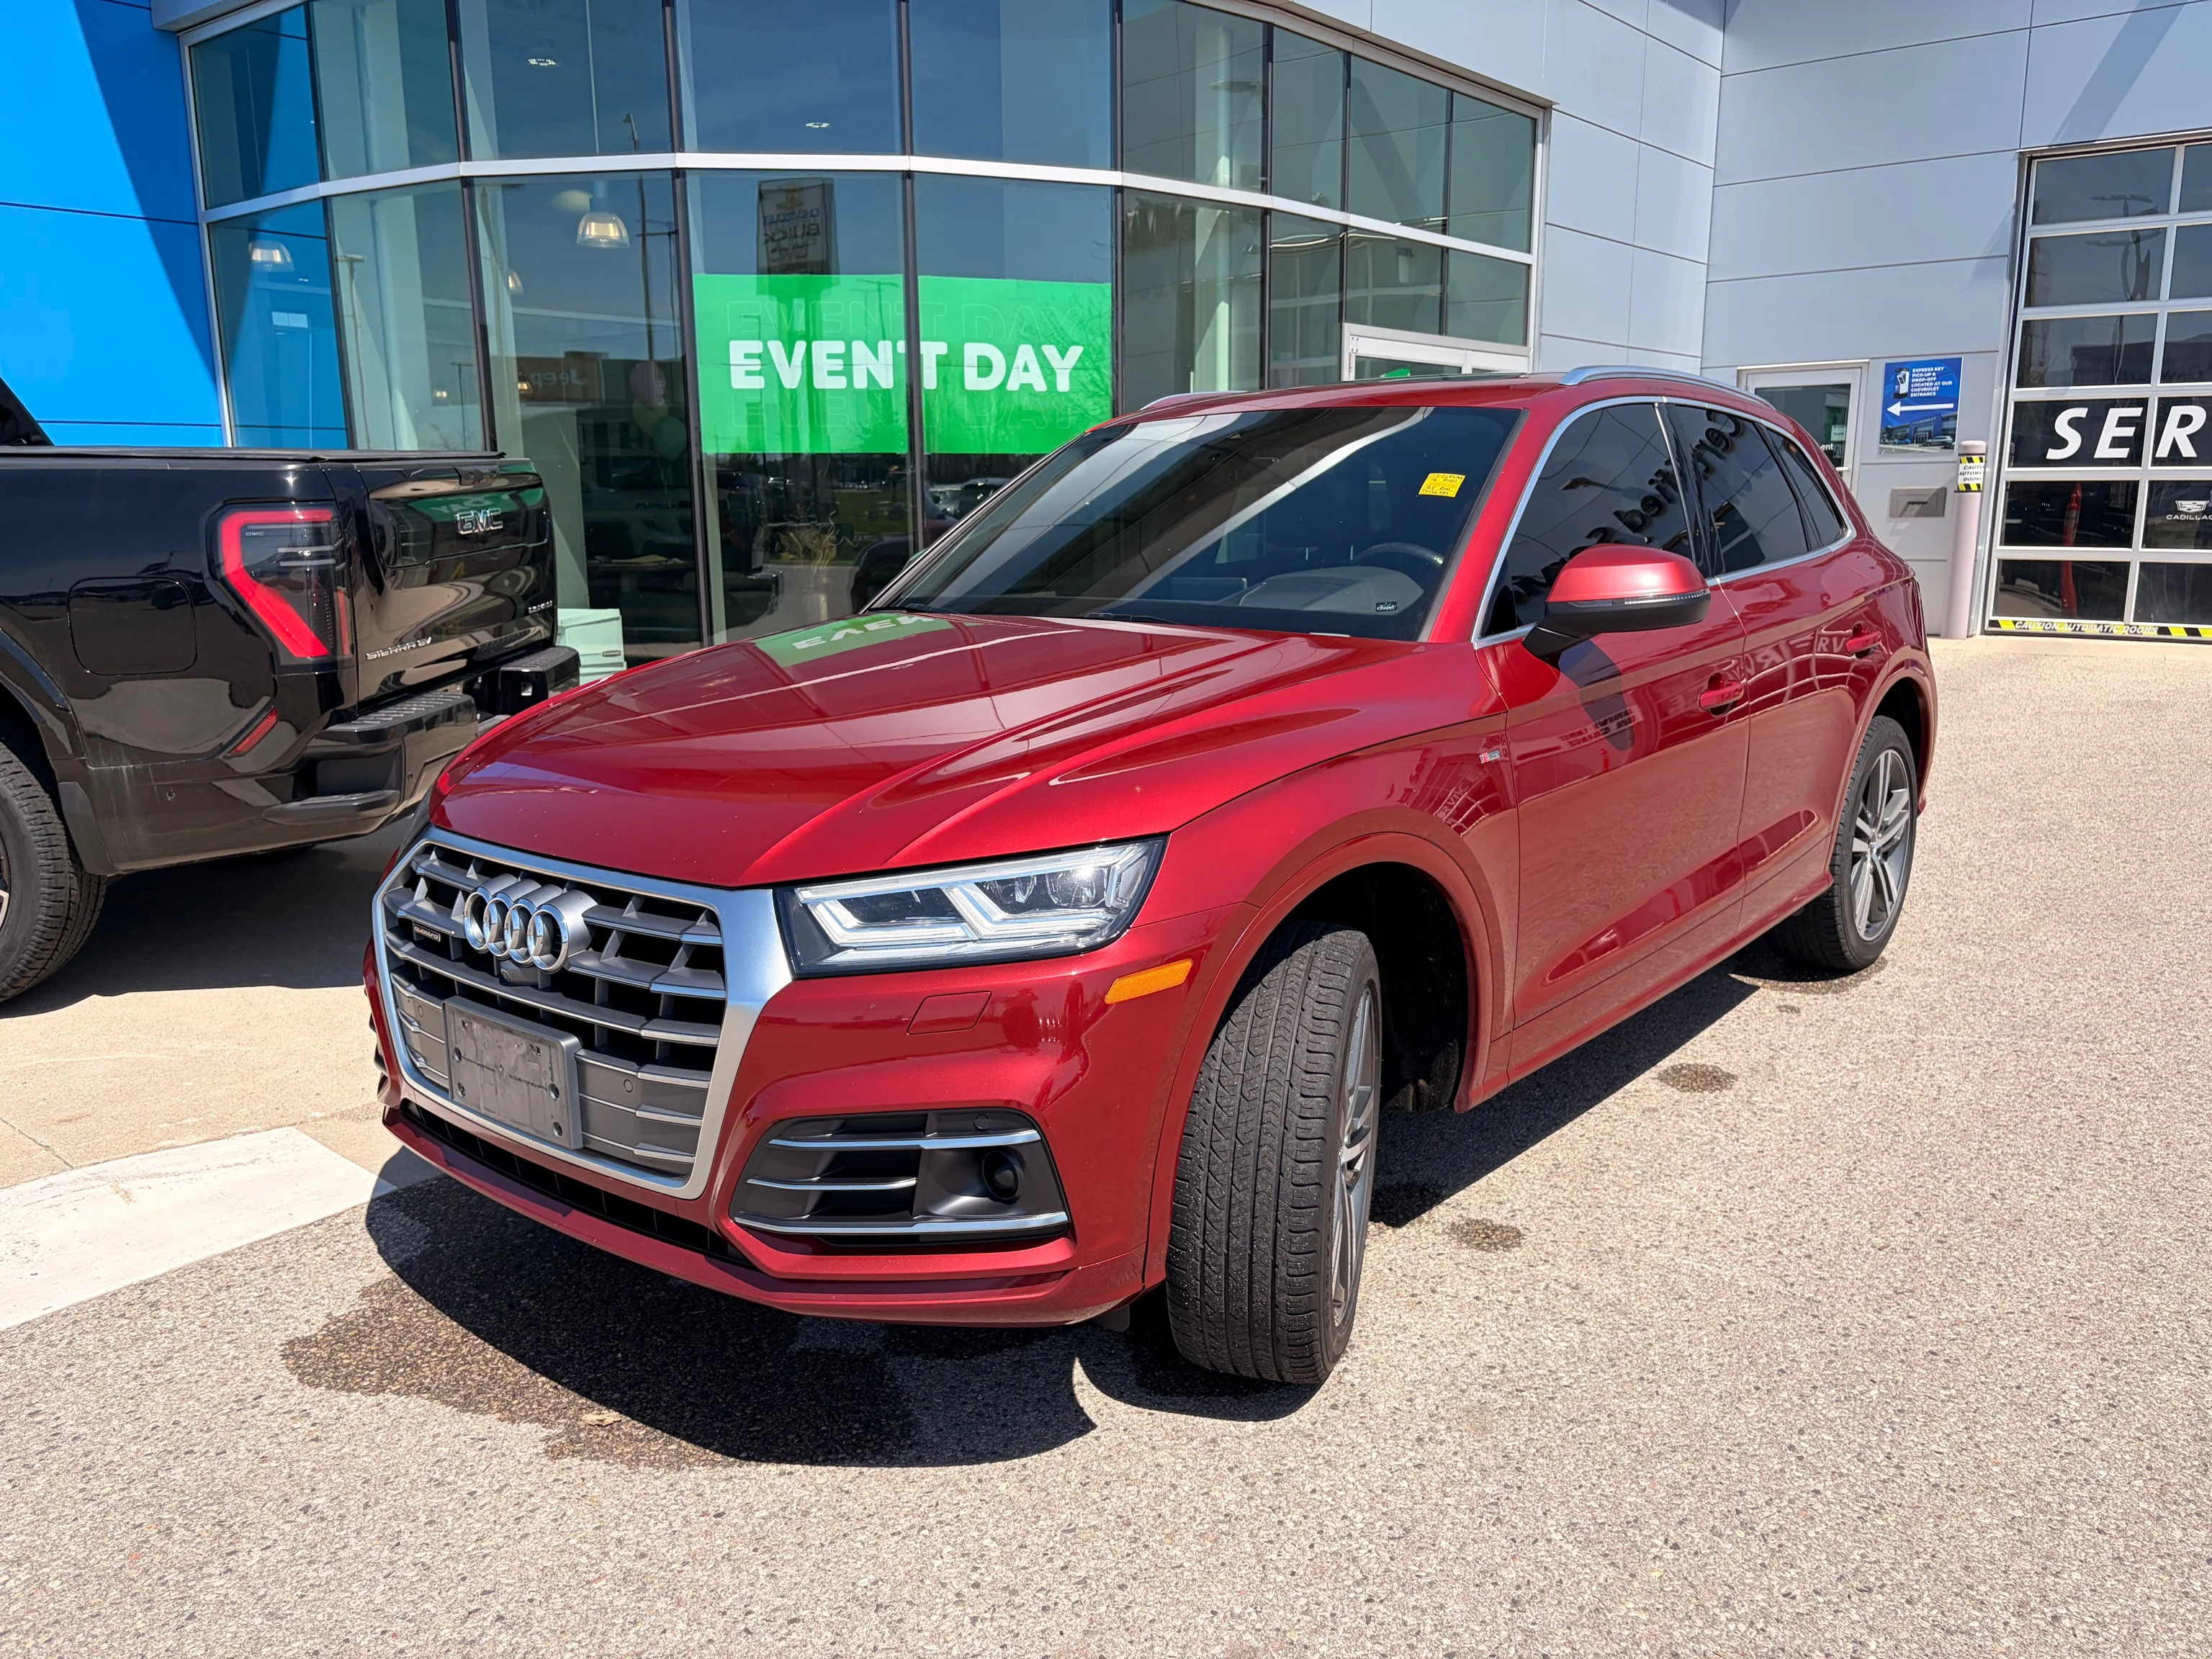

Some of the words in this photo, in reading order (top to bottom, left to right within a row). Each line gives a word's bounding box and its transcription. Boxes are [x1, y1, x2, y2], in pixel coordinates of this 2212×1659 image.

[729, 340, 948, 390] EVENT
[963, 342, 1084, 392] DAY
[454, 507, 504, 535] GMC
[2015, 621, 2060, 631] CAUTION
[2061, 622, 2121, 634] AUTOMATIC
[2121, 624, 2159, 634] DOORS
[366, 642, 416, 660] SIERRA
[414, 926, 439, 940] quattro
